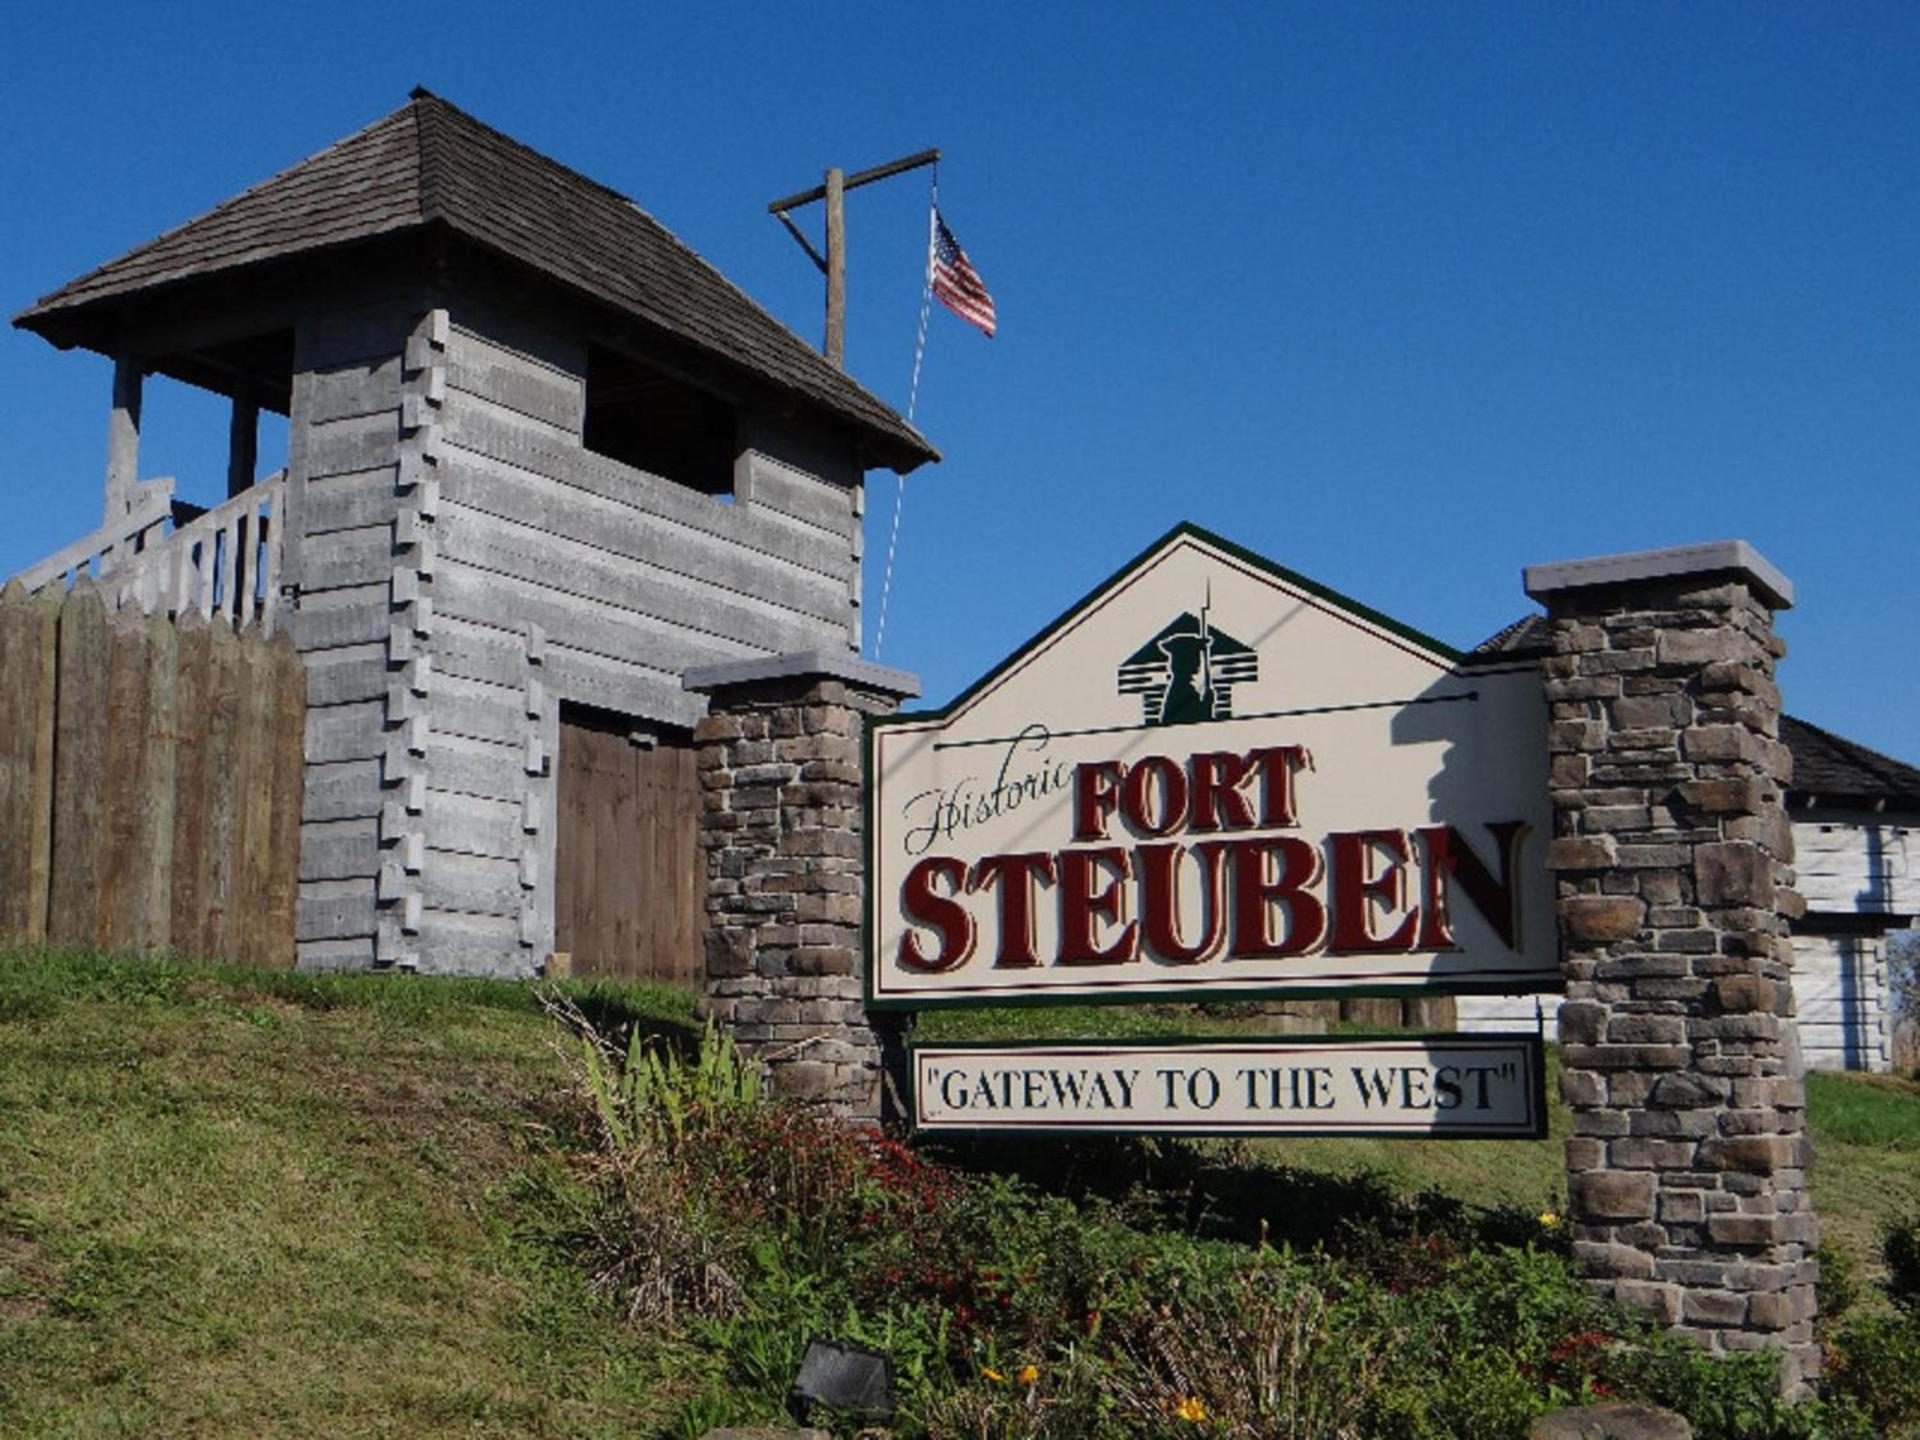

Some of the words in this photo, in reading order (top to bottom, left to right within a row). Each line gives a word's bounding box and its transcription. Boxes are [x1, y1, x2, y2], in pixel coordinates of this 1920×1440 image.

[904, 724, 1070, 855] Historic
[1073, 744, 1315, 841] FORT
[896, 819, 1532, 974] STEUBEN
[927, 1067, 1140, 1112] "GATEWAY
[1156, 1068, 1221, 1111] TO
[1236, 1068, 1337, 1110] THE
[1350, 1063, 1517, 1110] WEST"
